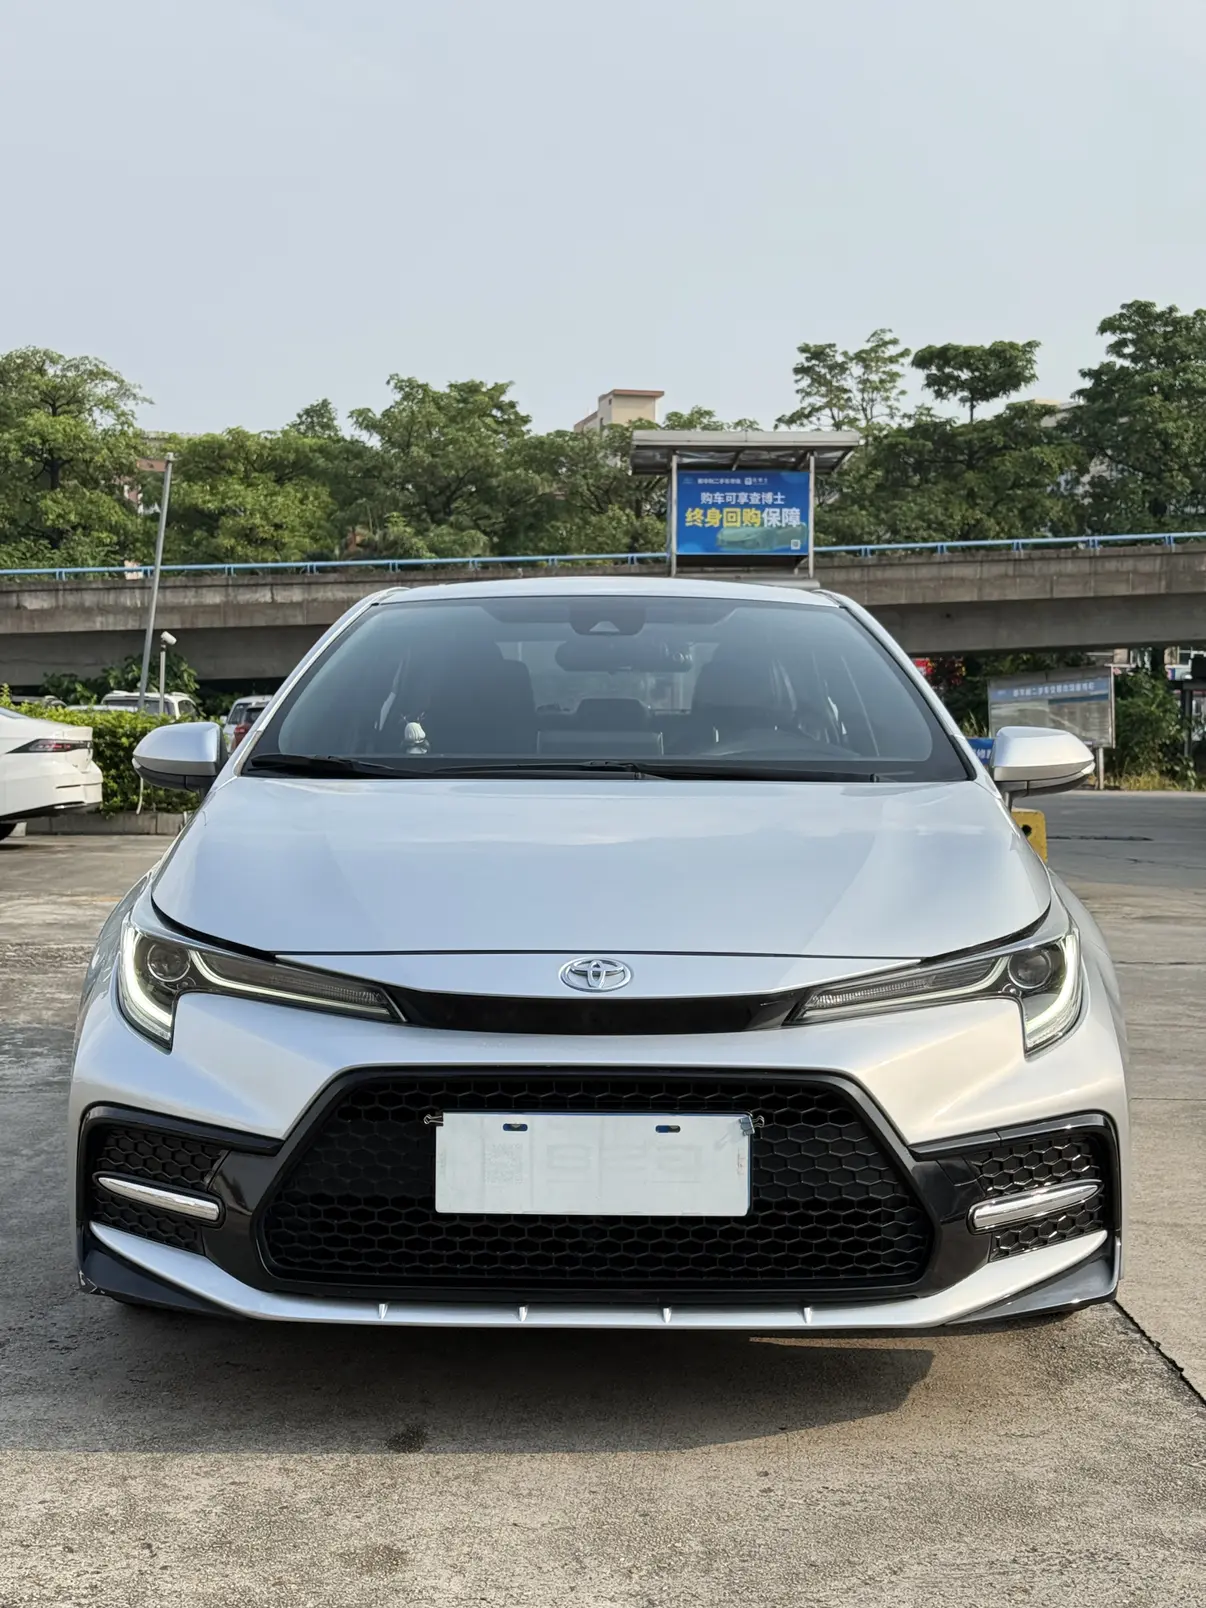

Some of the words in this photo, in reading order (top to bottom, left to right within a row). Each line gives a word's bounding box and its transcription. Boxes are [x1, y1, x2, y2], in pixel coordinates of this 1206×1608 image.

[700, 492, 786, 505] 购车可享查博士
[685, 507, 801, 528] 终身回购保障
